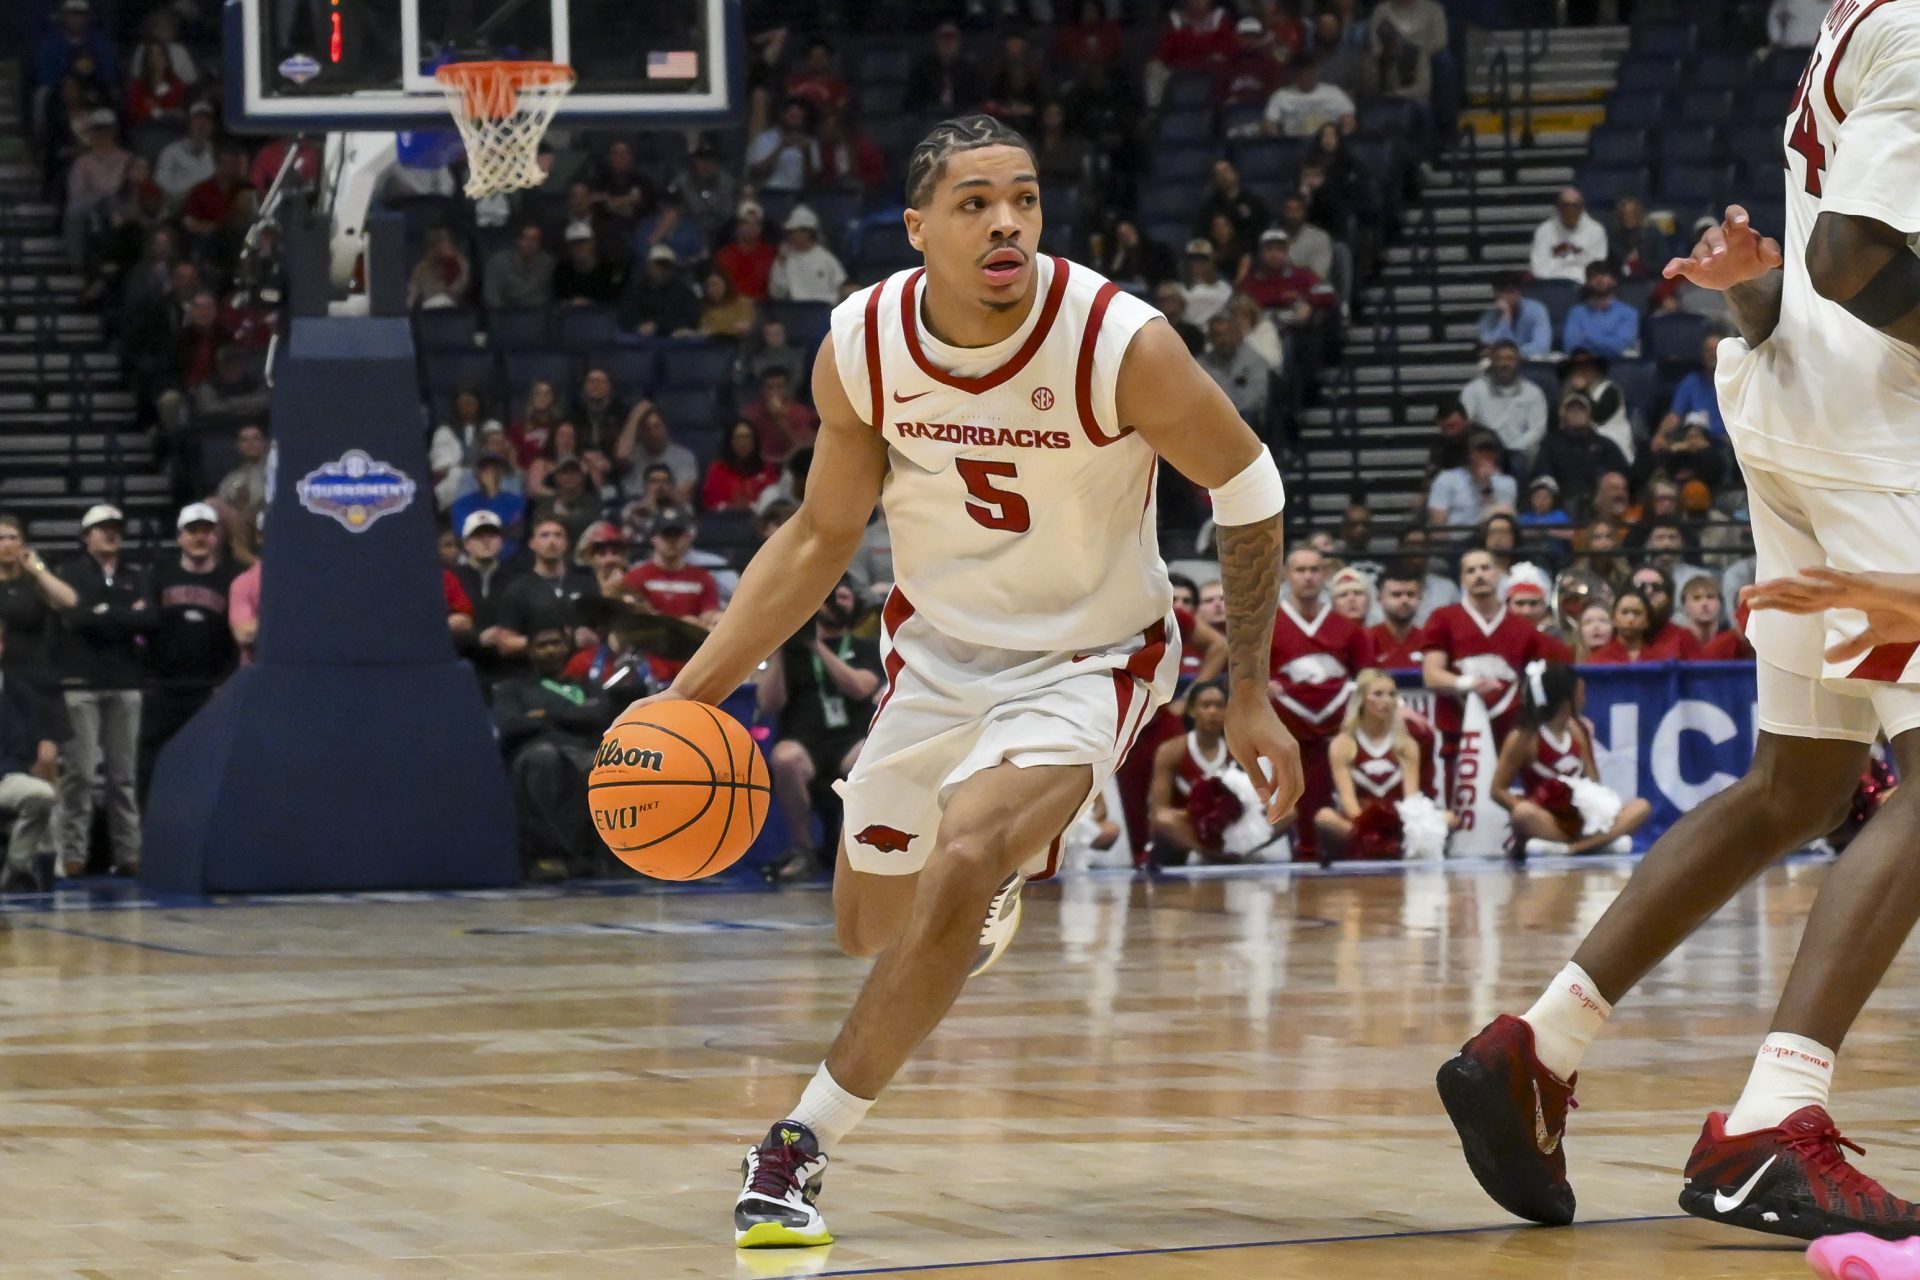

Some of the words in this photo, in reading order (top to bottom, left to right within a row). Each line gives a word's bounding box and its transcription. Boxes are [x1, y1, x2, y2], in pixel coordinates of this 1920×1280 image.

[1032, 387, 1054, 410] SEC
[895, 421, 1071, 449] RAZORBACKS
[955, 456, 1031, 533] 5
[594, 737, 662, 771] ilson
[1761, 1044, 1829, 1069] Supreme
